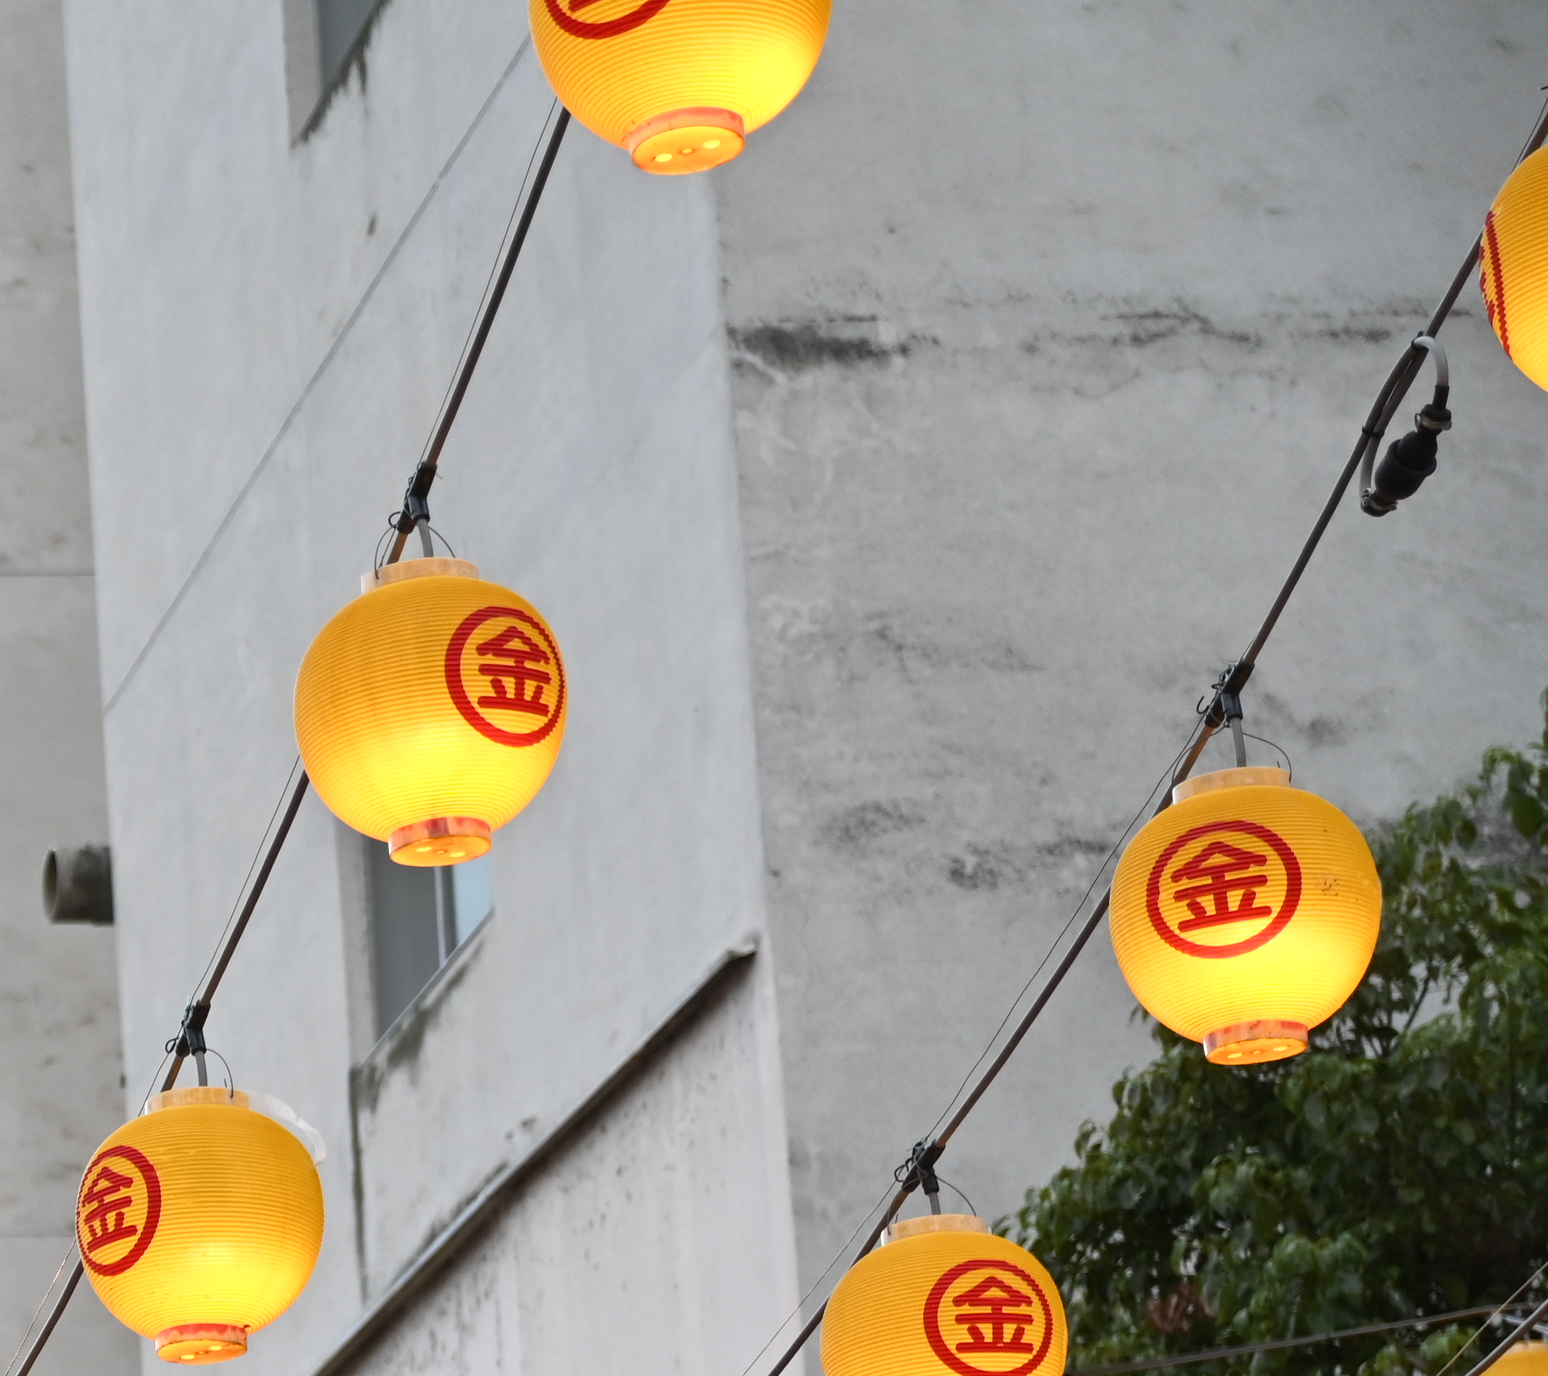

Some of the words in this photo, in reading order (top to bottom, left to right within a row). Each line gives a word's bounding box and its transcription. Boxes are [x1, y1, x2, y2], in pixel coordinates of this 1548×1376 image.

[476, 626, 553, 717] 金
[1171, 841, 1273, 932] 金
[83, 1167, 138, 1252] 金
[953, 1276, 1035, 1354] 金
